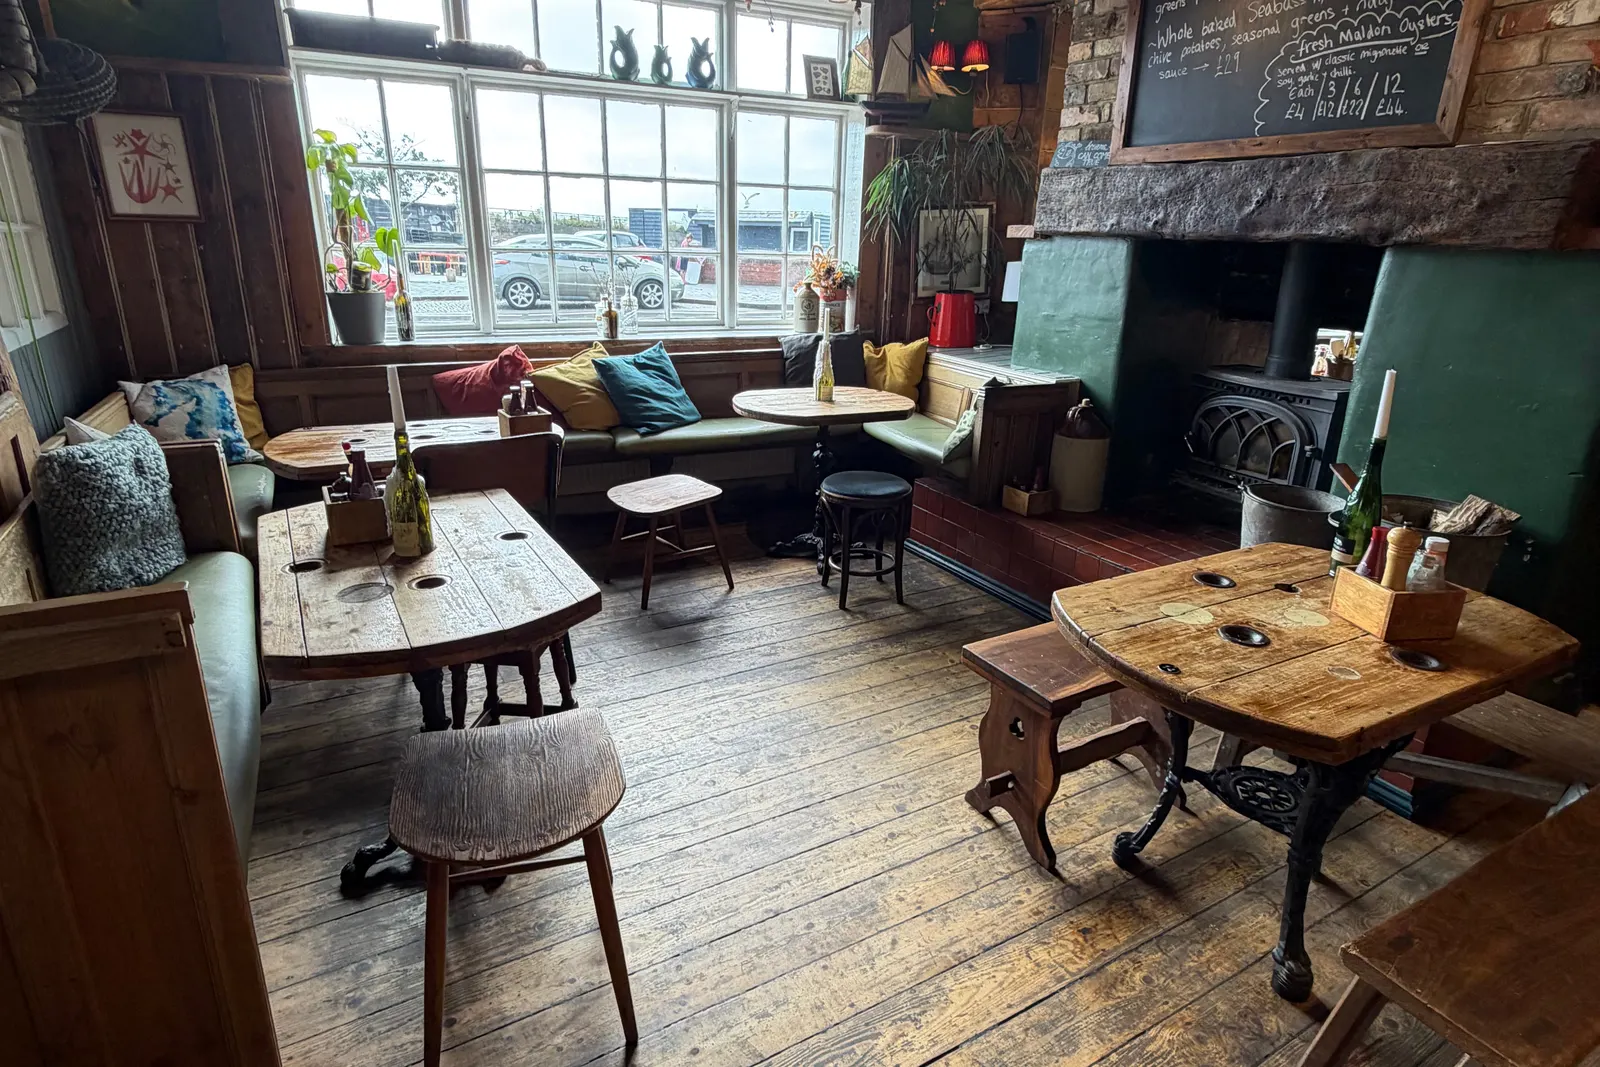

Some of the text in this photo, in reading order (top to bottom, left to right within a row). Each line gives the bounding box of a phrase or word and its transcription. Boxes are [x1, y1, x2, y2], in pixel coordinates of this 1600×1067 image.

[1201, 9, 1237, 37] baked
[1339, 25, 1392, 44] Maldon
[1399, 13, 1454, 46] Oysters
[1147, 51, 1173, 69] chive
[1231, 20, 1281, 46] seasonal
[1291, 7, 1336, 38] greens
[1324, 50, 1356, 66] classic
[1158, 66, 1189, 80] sauce
